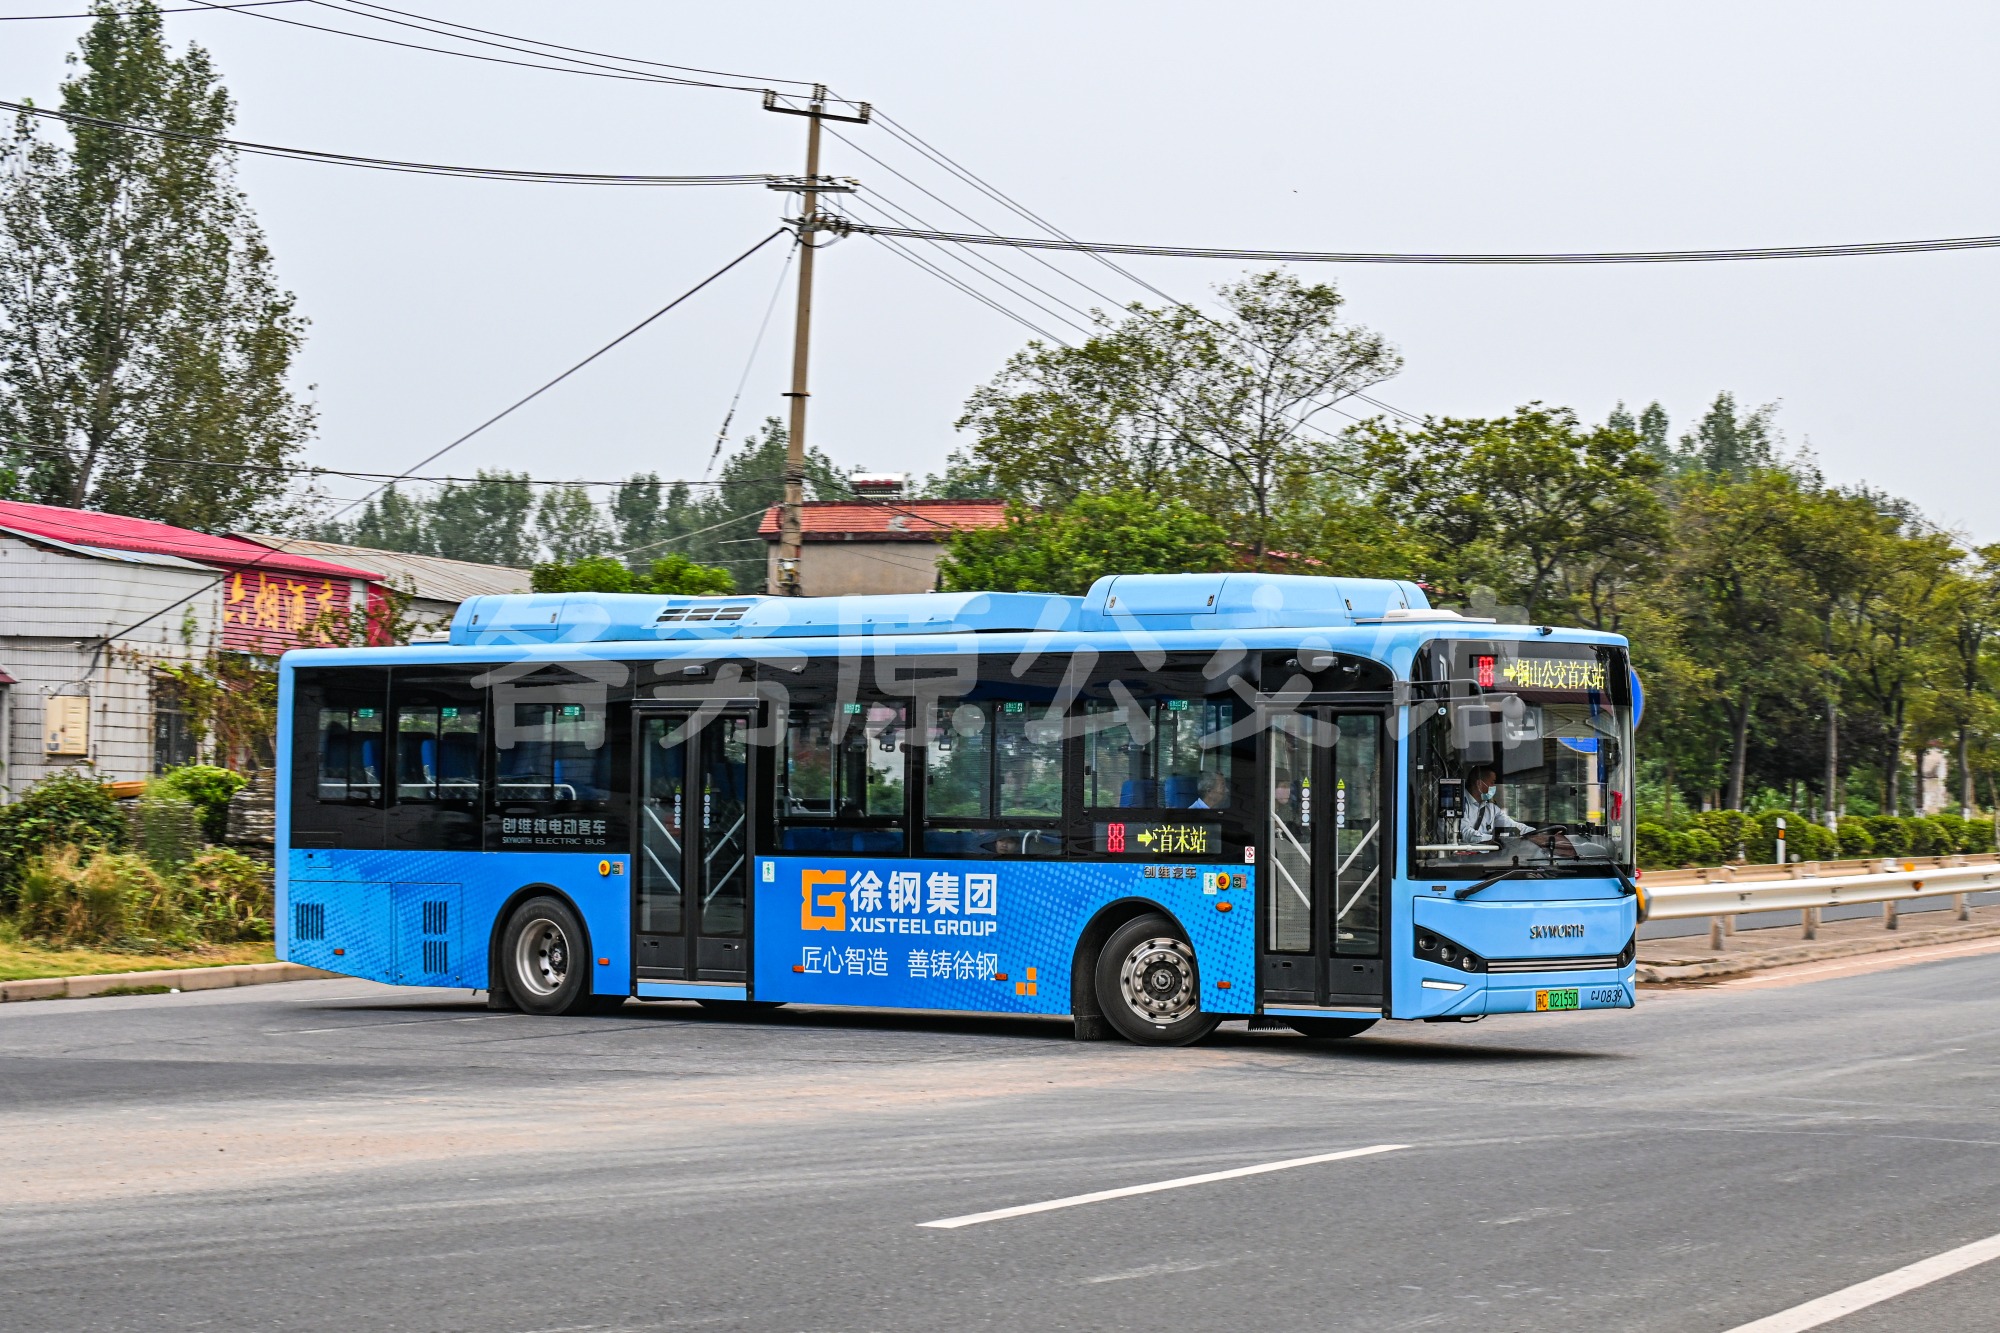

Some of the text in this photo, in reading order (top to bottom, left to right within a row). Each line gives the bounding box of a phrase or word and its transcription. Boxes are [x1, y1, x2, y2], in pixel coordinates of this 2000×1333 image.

[502, 817, 606, 836] 创维纯电动客车
[535, 837, 582, 845] ELECTRIC
[584, 838, 606, 846] BUS
[849, 870, 998, 916] 徐钢集团
[849, 917, 997, 937] XUSTEEL GROUP
[1529, 924, 1585, 940] SKYWORTH
[802, 946, 998, 981] 匠心智造 善铸徐钢
